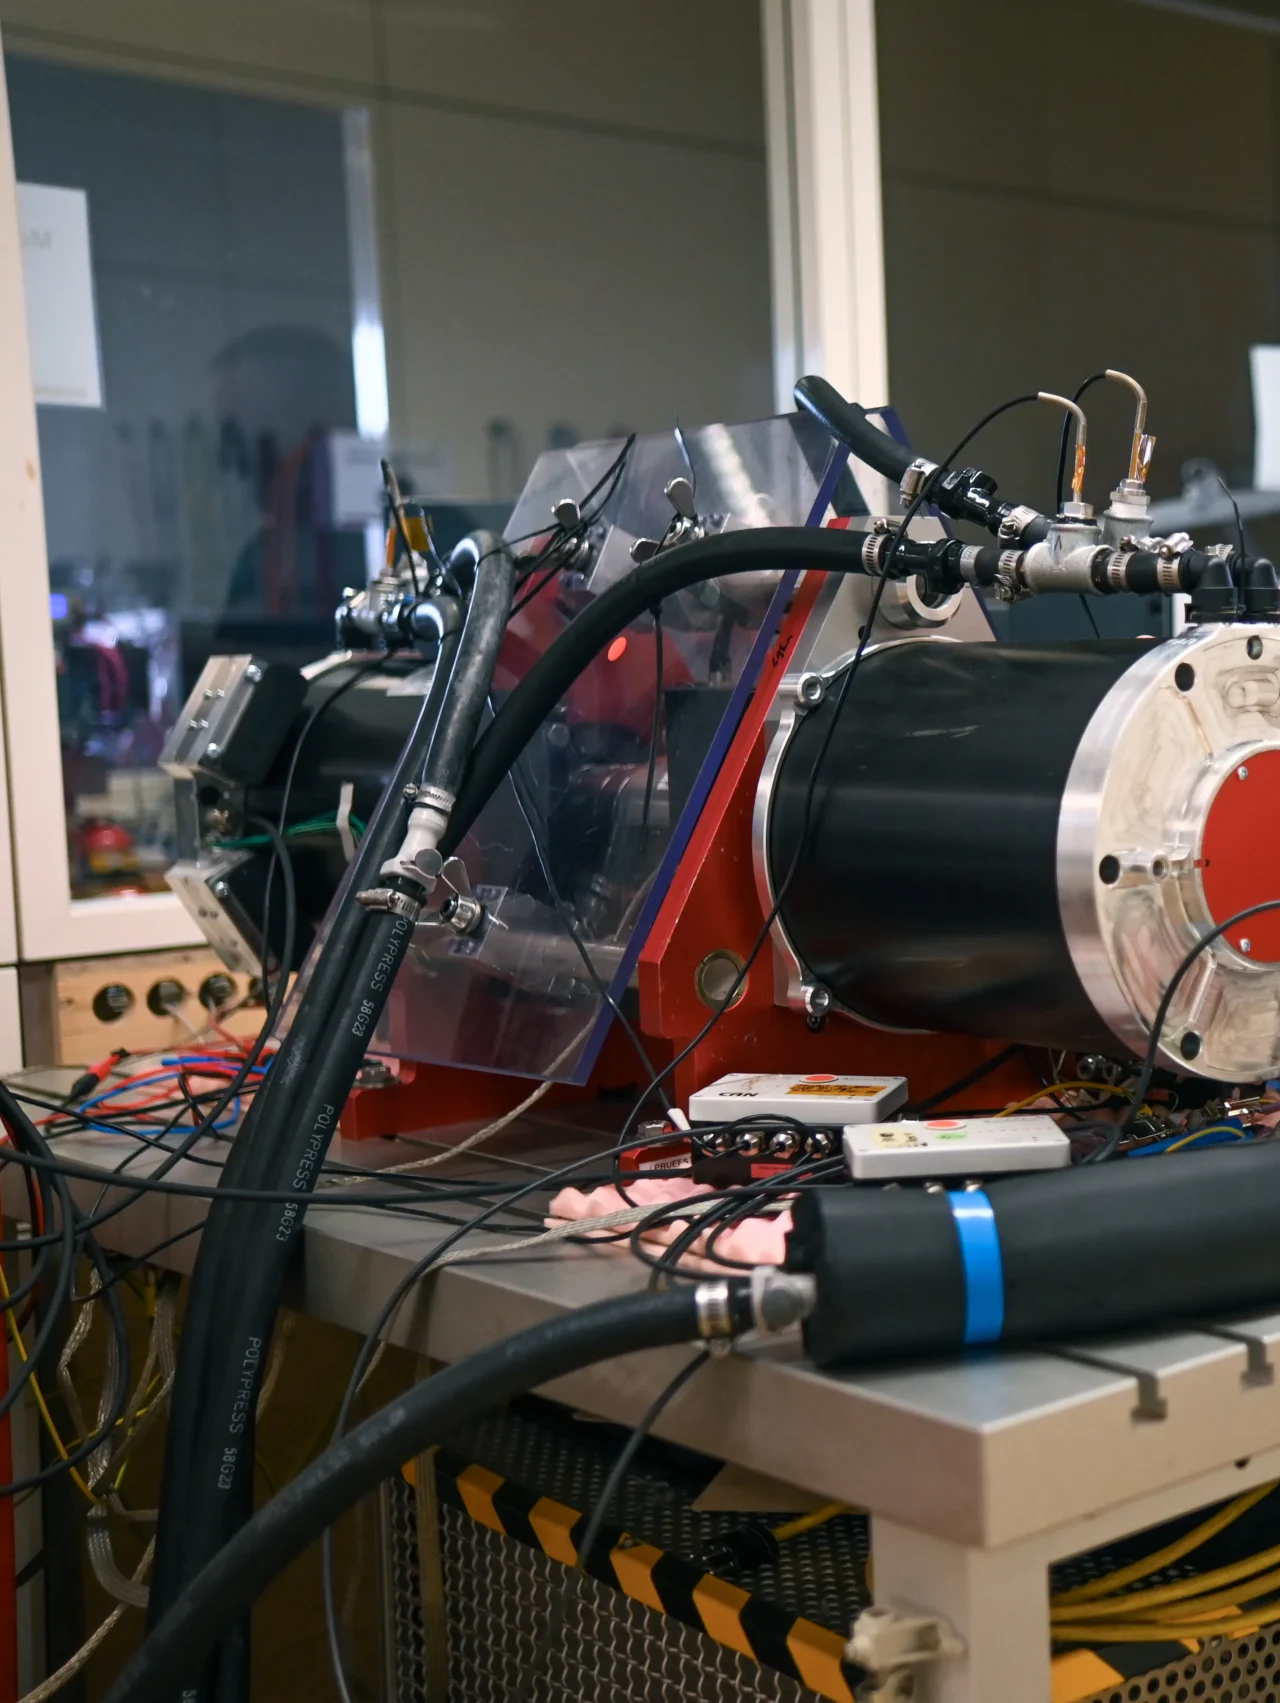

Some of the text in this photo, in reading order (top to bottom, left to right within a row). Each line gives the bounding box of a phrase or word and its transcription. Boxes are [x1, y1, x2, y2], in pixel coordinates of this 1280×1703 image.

[352, 917, 408, 1037] OLYPRESS 58G23
[276, 1103, 335, 1242] POLYPRESS 58G23
[653, 1156, 693, 1170] PRUEFS
[217, 1336, 262, 1490] POLYPRESS 58G23
